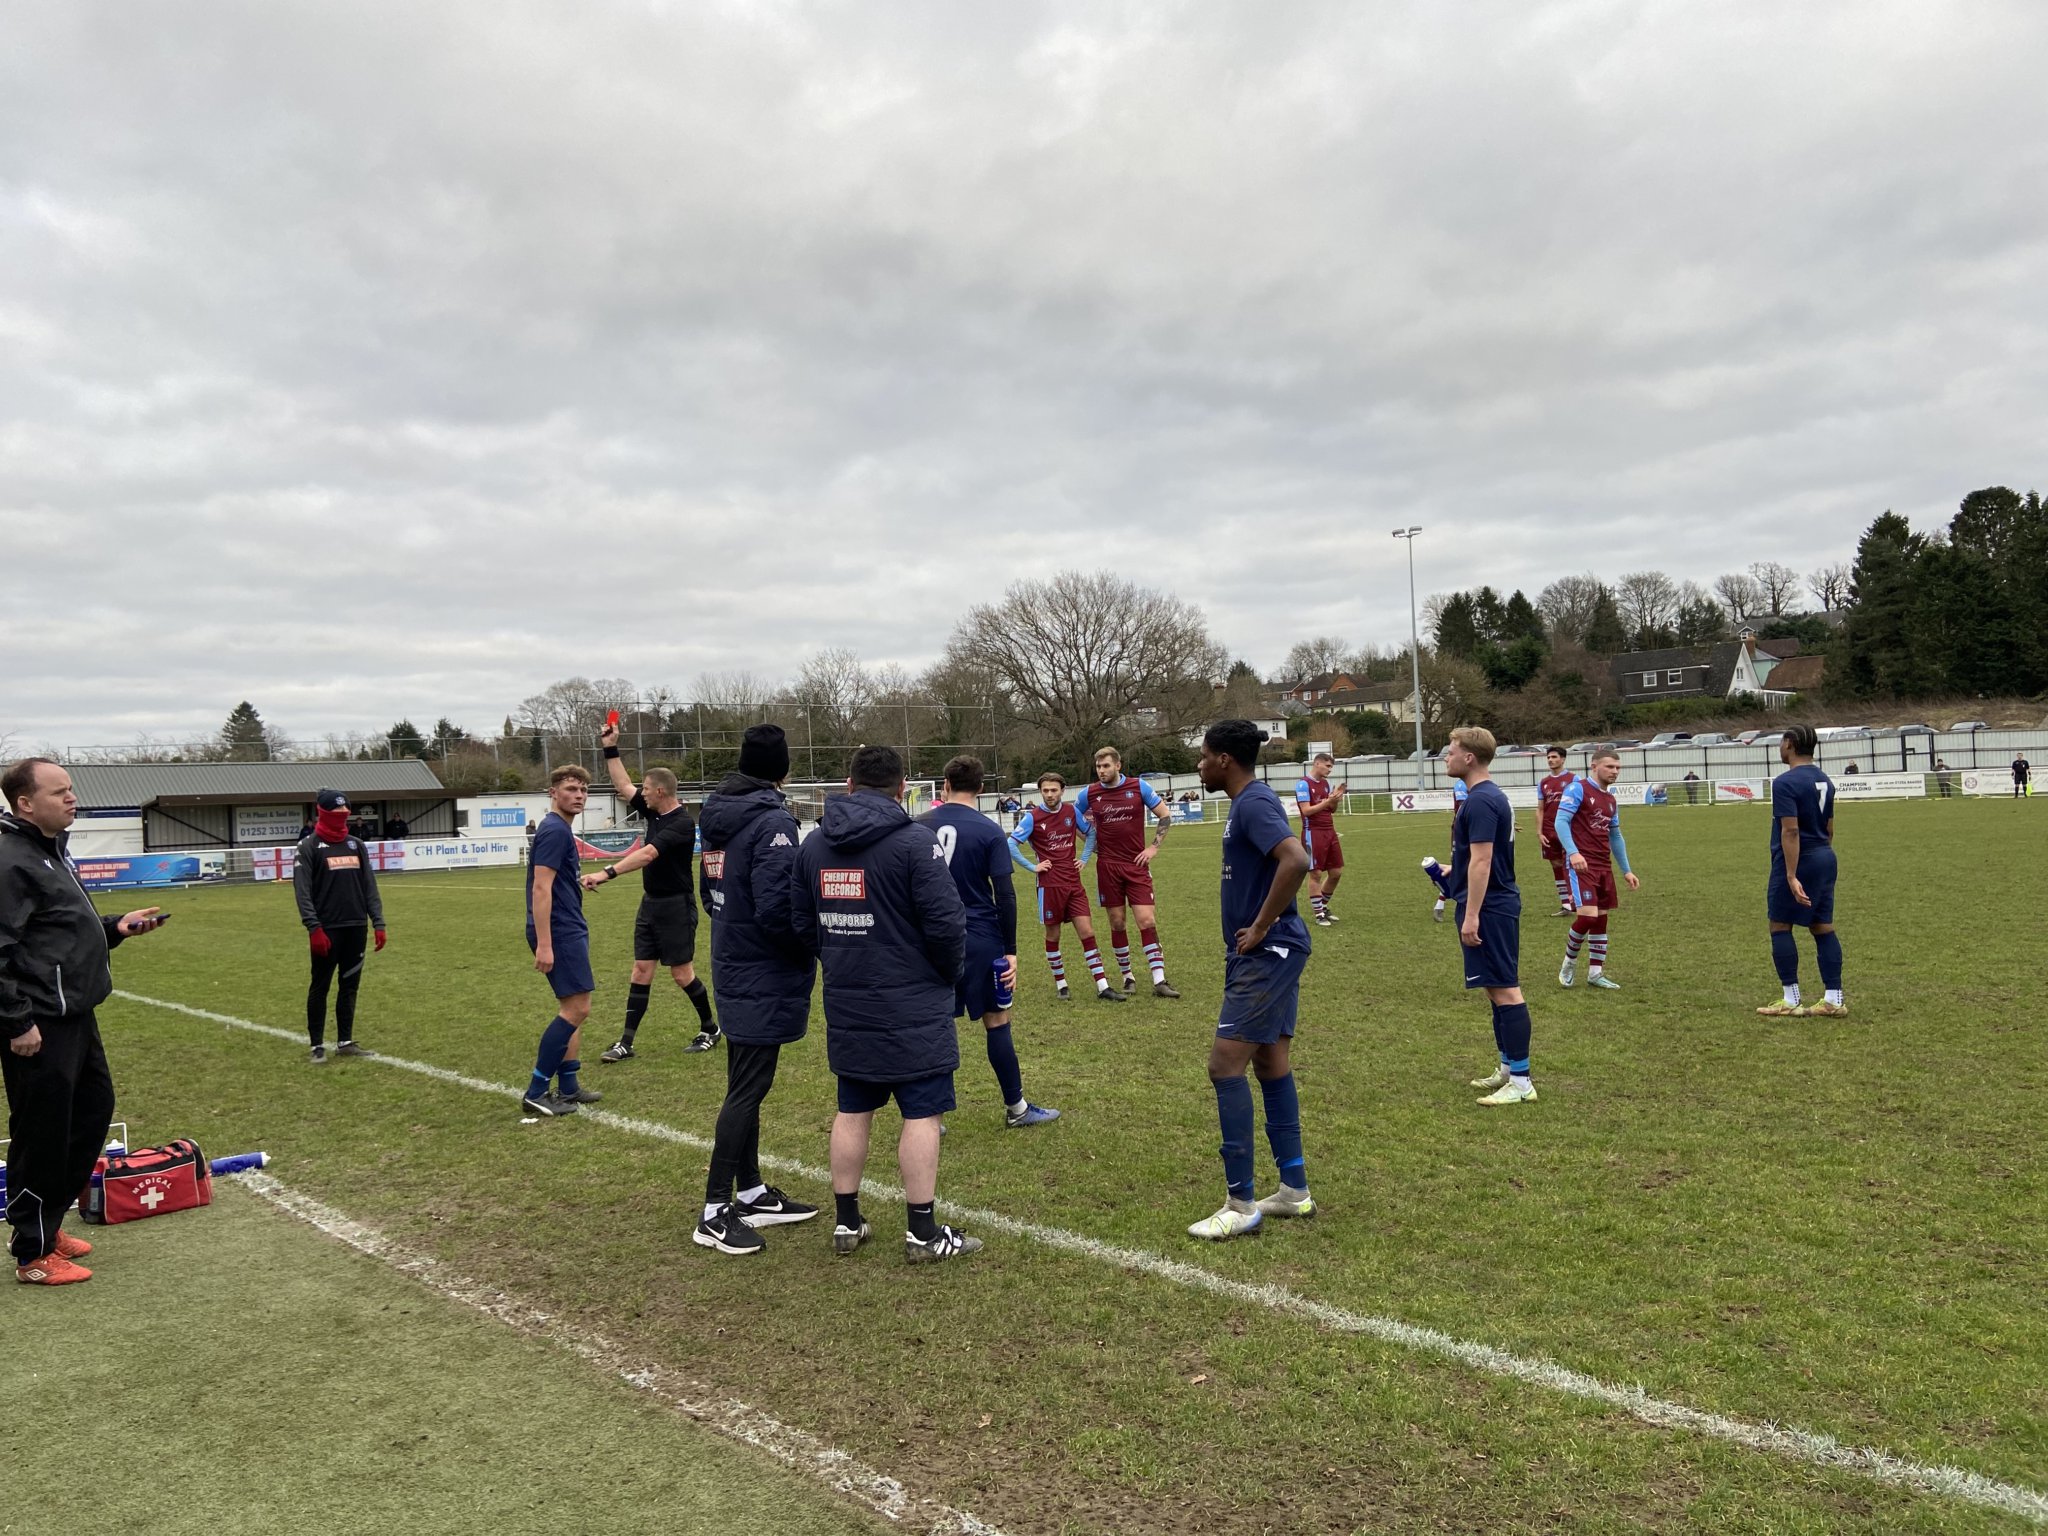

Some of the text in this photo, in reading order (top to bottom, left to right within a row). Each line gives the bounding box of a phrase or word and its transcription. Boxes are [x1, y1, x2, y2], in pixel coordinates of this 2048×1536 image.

[1815, 781, 1829, 815] 7
[253, 811, 267, 819] Plant
[482, 811, 518, 825] OPERATIX
[69, 832, 88, 840] ancial
[240, 825, 300, 837] 01252 333122
[436, 843, 458, 855] Plant
[461, 844, 468, 854] &
[471, 842, 488, 853] Tool
[491, 842, 509, 852] Hire
[937, 825, 957, 868] 9
[79, 862, 130, 872] LOGISTICS SOLUTIONS
[80, 872, 91, 880] YOU
[101, 871, 116, 879] TRUST
[823, 872, 861, 882] CHERRY RED
[824, 883, 861, 896] RECORDS
[132, 1176, 172, 1195] MEDICAL
